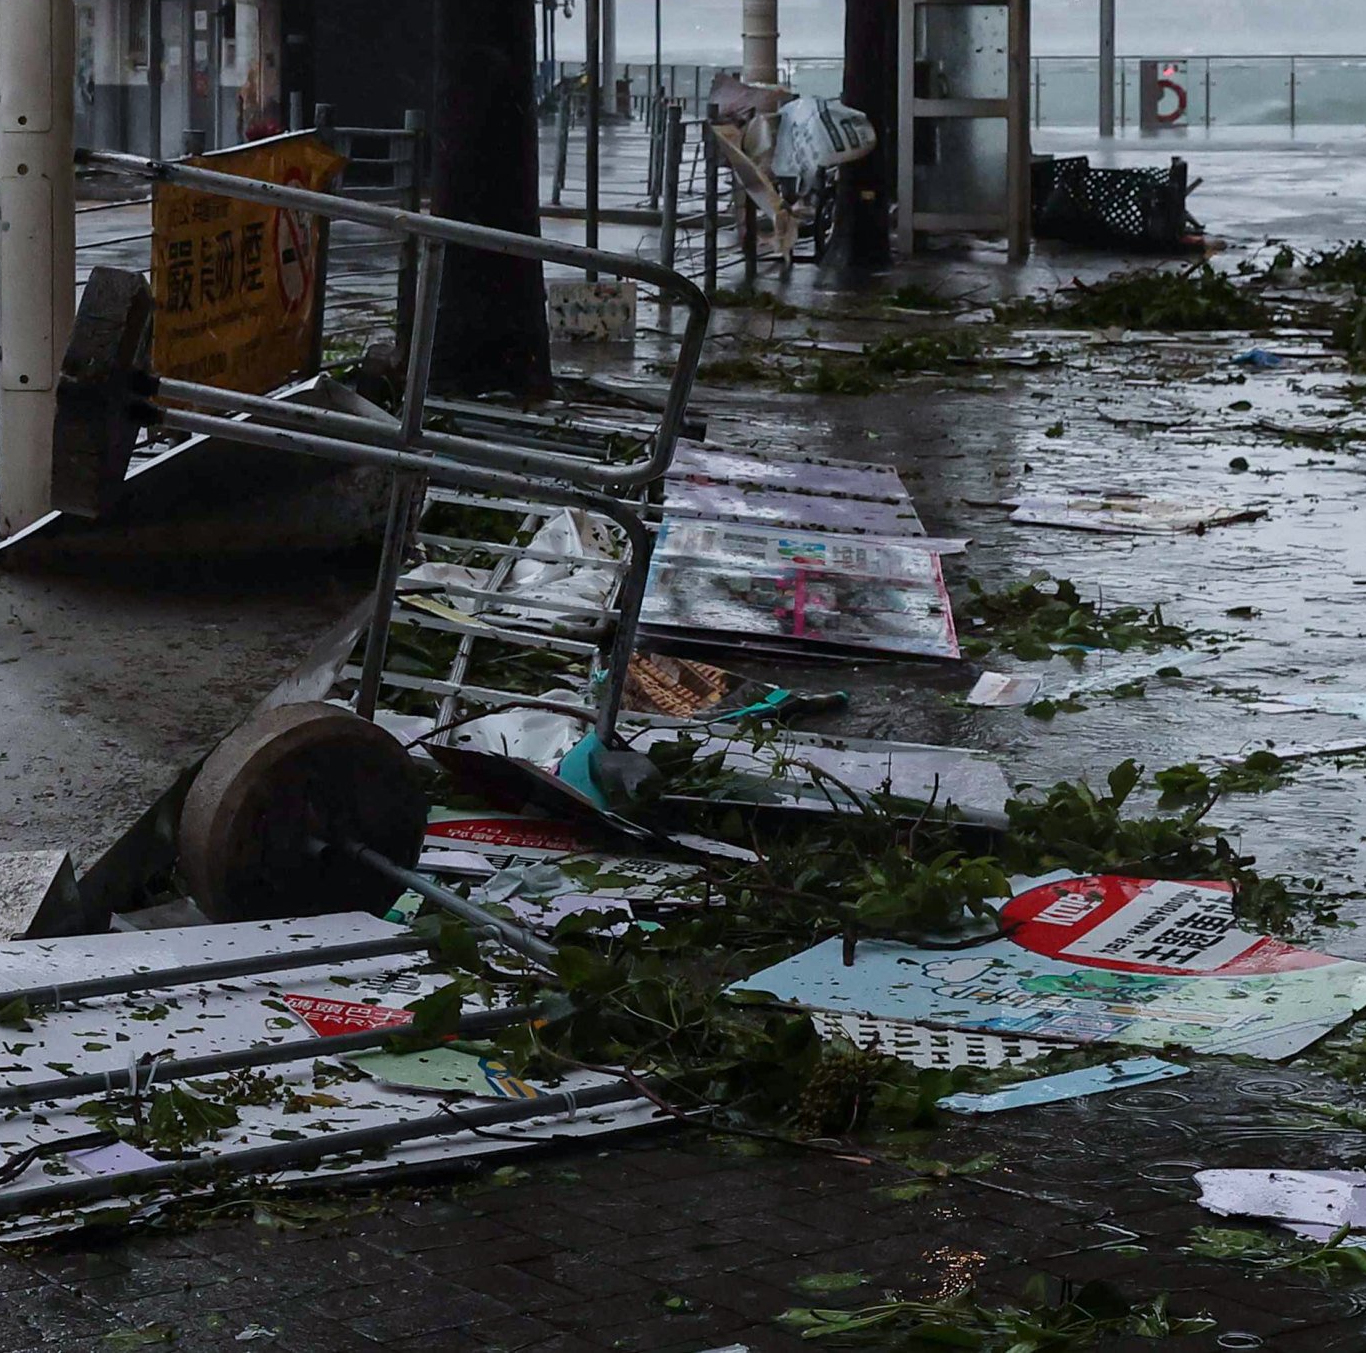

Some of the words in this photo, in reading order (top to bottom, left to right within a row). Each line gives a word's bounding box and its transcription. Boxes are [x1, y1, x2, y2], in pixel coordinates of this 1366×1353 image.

[286, 996, 415, 1025] 碼頭巴士
[302, 1012, 385, 1030] ERRY
